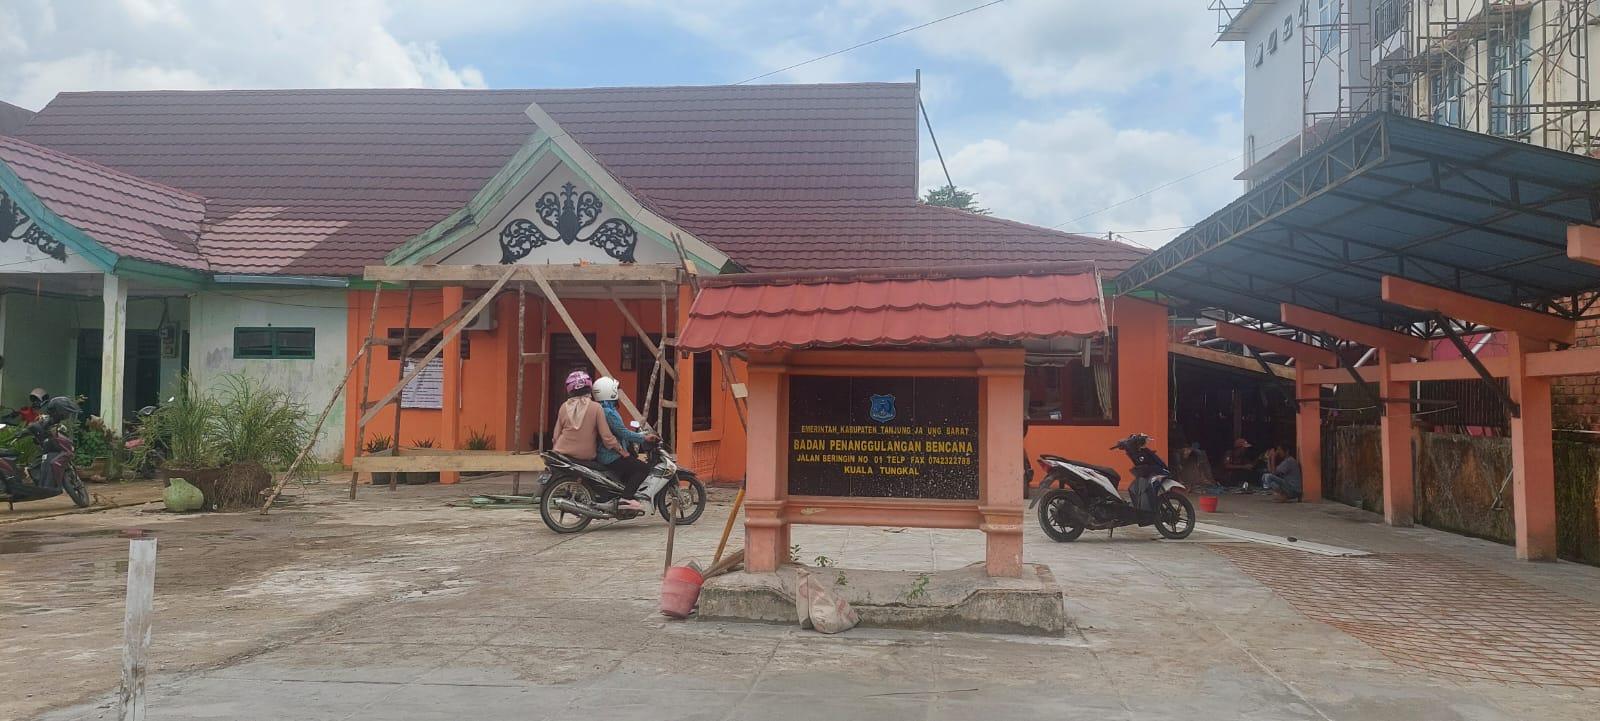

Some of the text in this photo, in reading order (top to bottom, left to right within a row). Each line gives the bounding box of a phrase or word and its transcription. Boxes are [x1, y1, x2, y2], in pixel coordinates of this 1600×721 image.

[840, 425, 877, 434] KABUPATEN
[881, 425, 911, 434] TANJUNG
[946, 427, 970, 436] BARAT
[793, 439, 973, 453] BADAN PENANGGULANGAN BENCANA
[797, 454, 820, 463] JALAN
[822, 454, 855, 463] BERINGIN
[858, 455, 869, 464] NO
[886, 455, 906, 464] TELP
[911, 456, 925, 465] FAX
[844, 466, 920, 475] KUALA TUNGKAL
